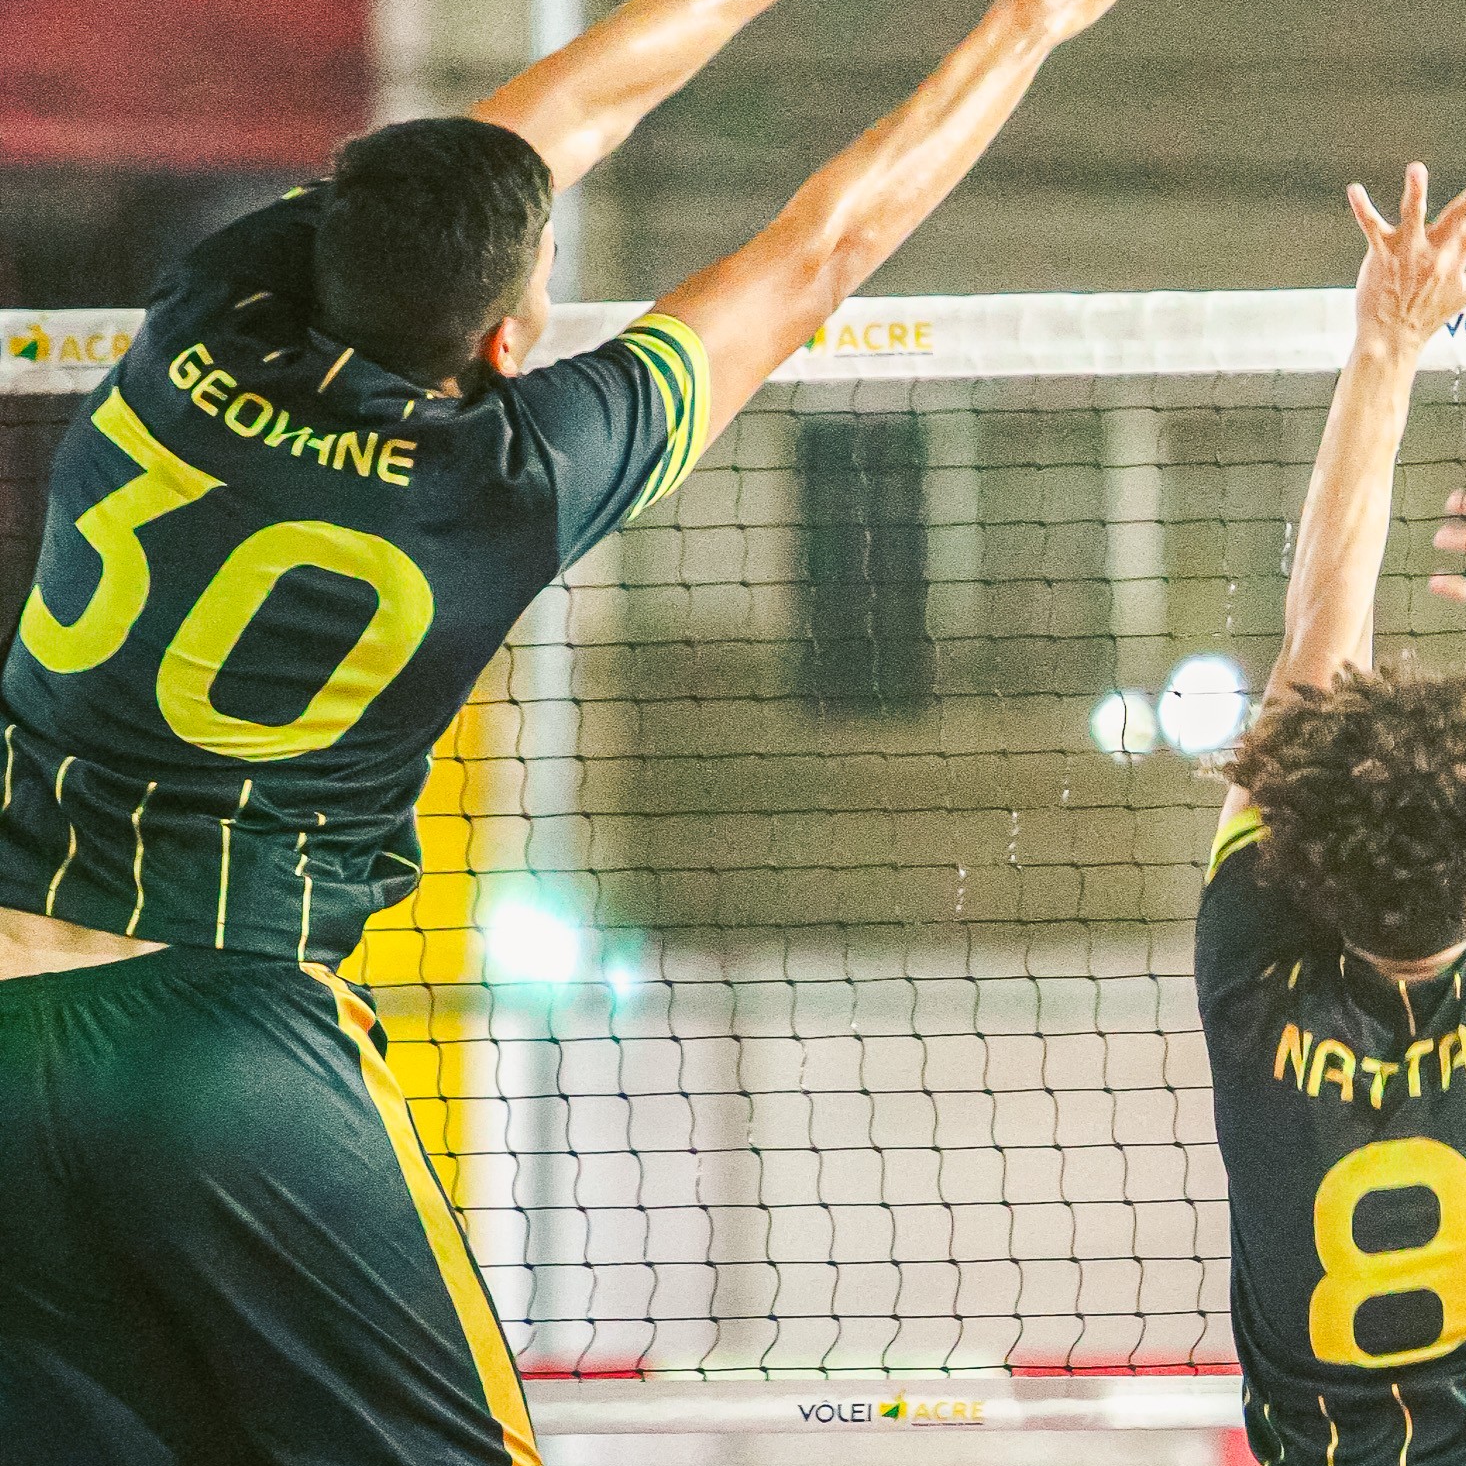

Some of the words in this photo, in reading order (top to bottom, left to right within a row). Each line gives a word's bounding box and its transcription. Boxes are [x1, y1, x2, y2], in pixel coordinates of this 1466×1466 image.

[60, 333, 133, 362] ACR
[836, 321, 934, 351] ACRE
[19, 386, 435, 762] 30
[797, 1400, 872, 1423] VÔLEI
[914, 1401, 985, 1421] ACRE
